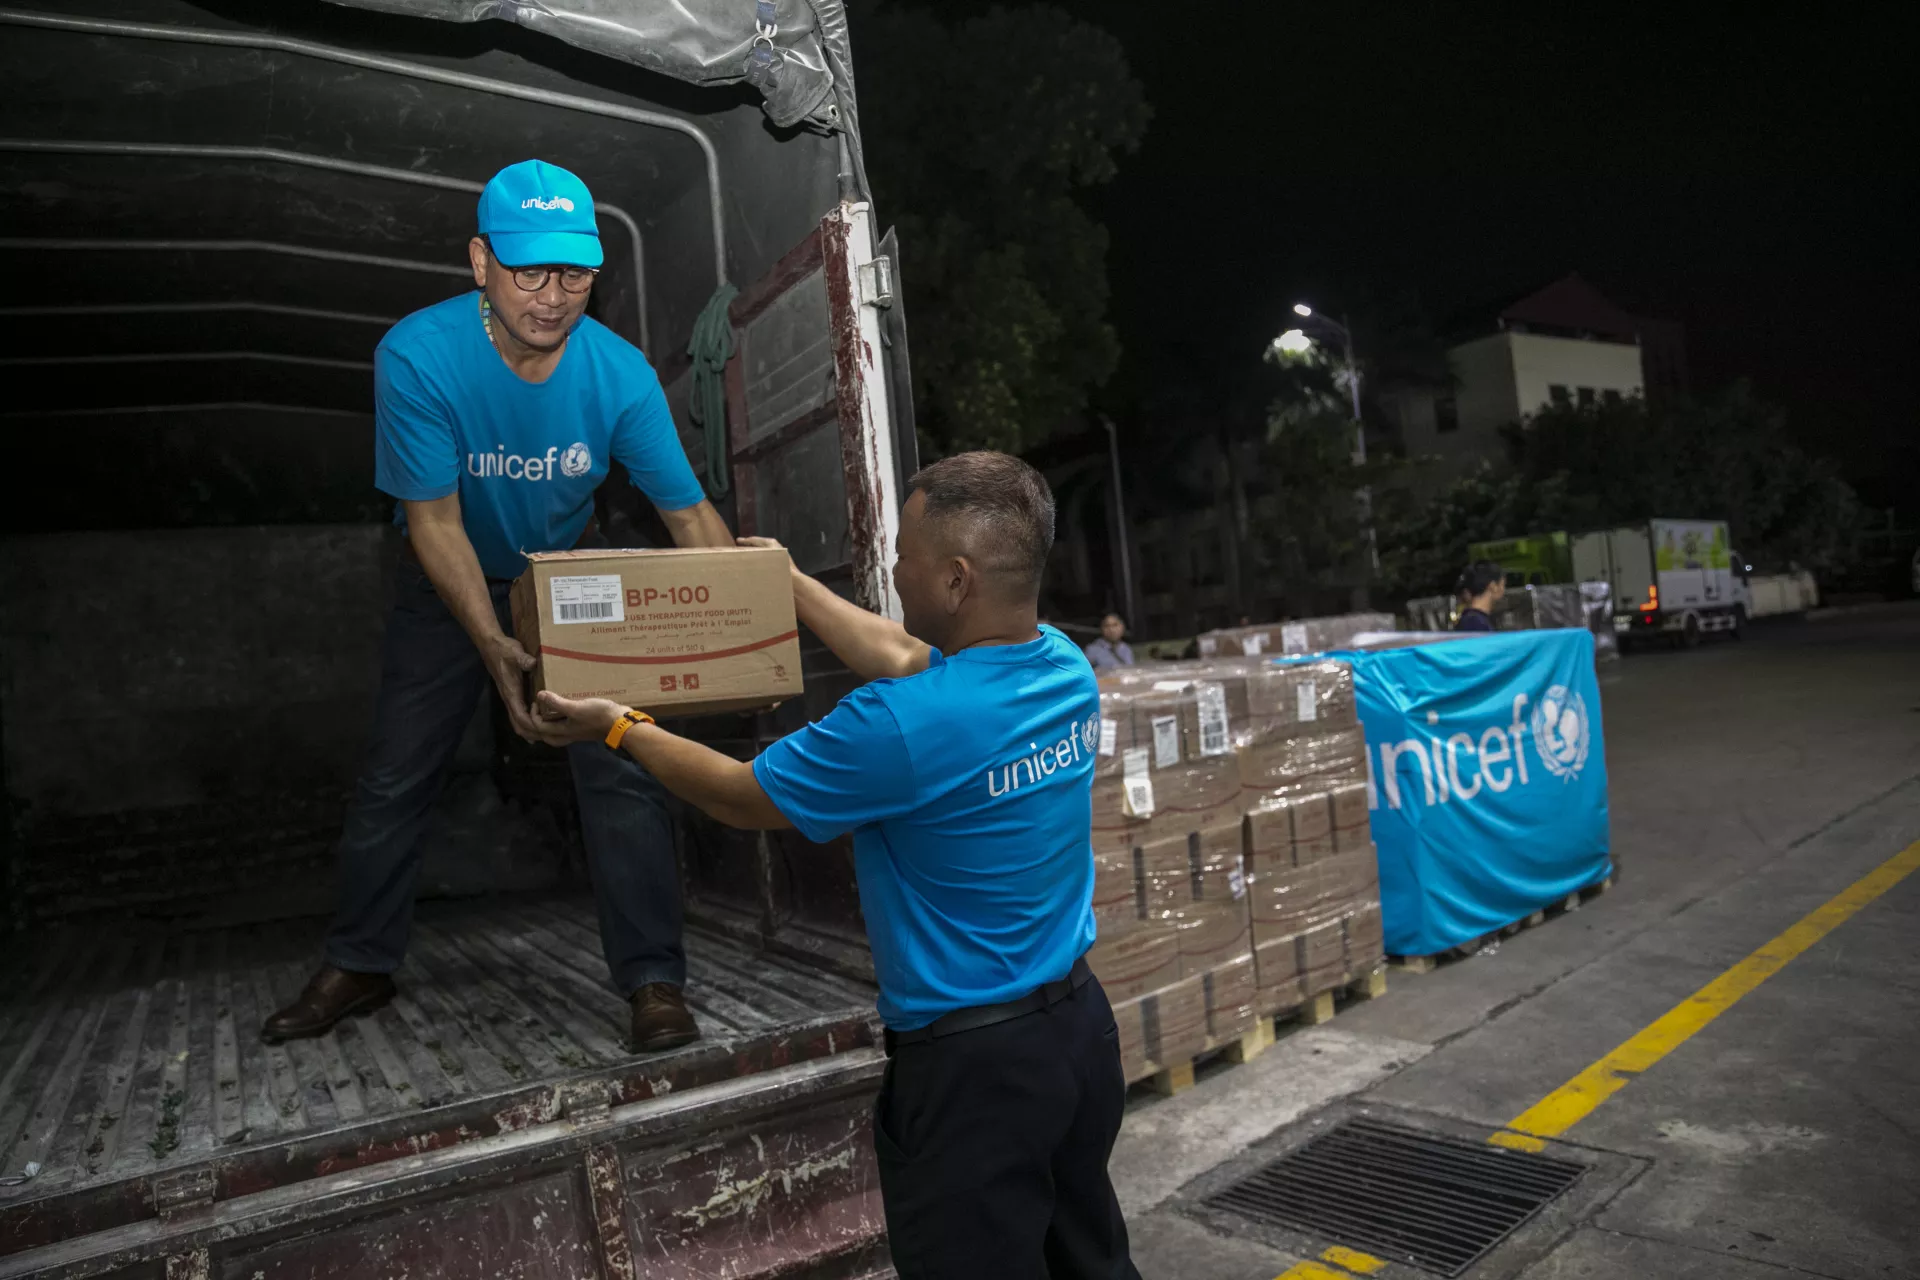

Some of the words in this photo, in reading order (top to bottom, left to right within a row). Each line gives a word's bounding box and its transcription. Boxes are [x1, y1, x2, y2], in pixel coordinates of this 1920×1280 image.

[521, 195, 561, 211] unicef
[467, 444, 558, 481] unicef
[626, 585, 710, 607] BP-100
[648, 610, 703, 620] THERAPEUTIC
[727, 608, 752, 617] (RUTF)
[657, 645, 676, 653] units
[987, 721, 1080, 797] unicef
